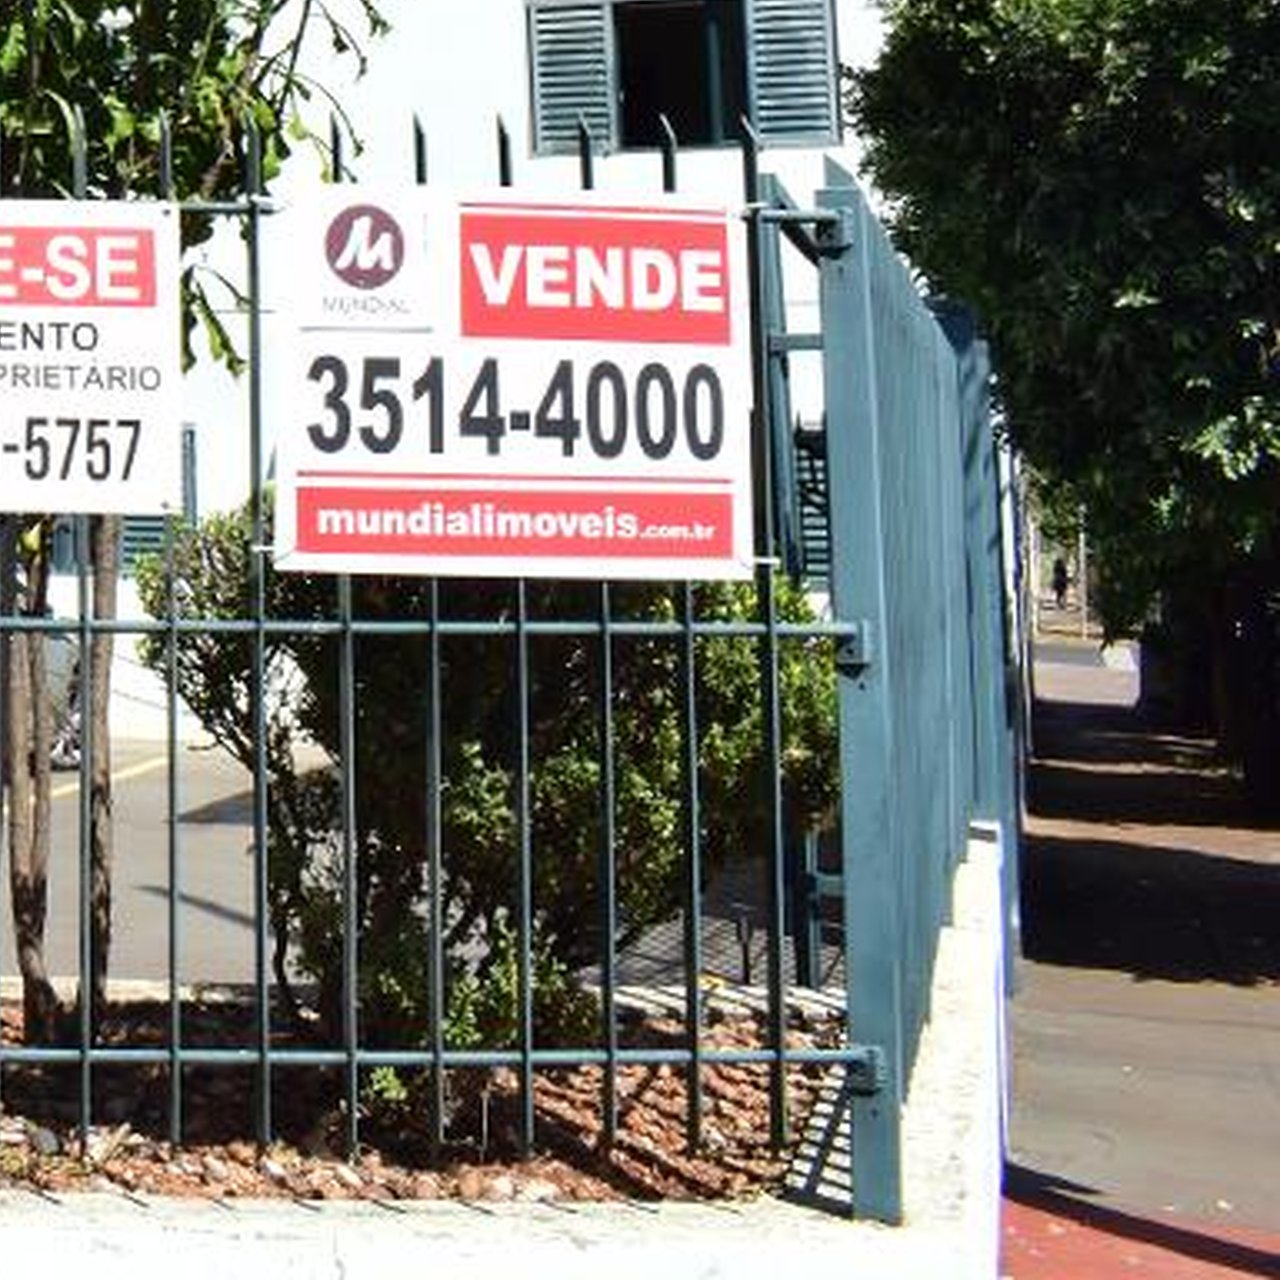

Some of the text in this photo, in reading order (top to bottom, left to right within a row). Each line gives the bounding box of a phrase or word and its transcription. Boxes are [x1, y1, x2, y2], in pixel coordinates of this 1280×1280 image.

[469, 242, 726, 313] VENDE
[306, 354, 725, 462] 3514-4000
[316, 503, 716, 542] mundialimoveis.com.br
